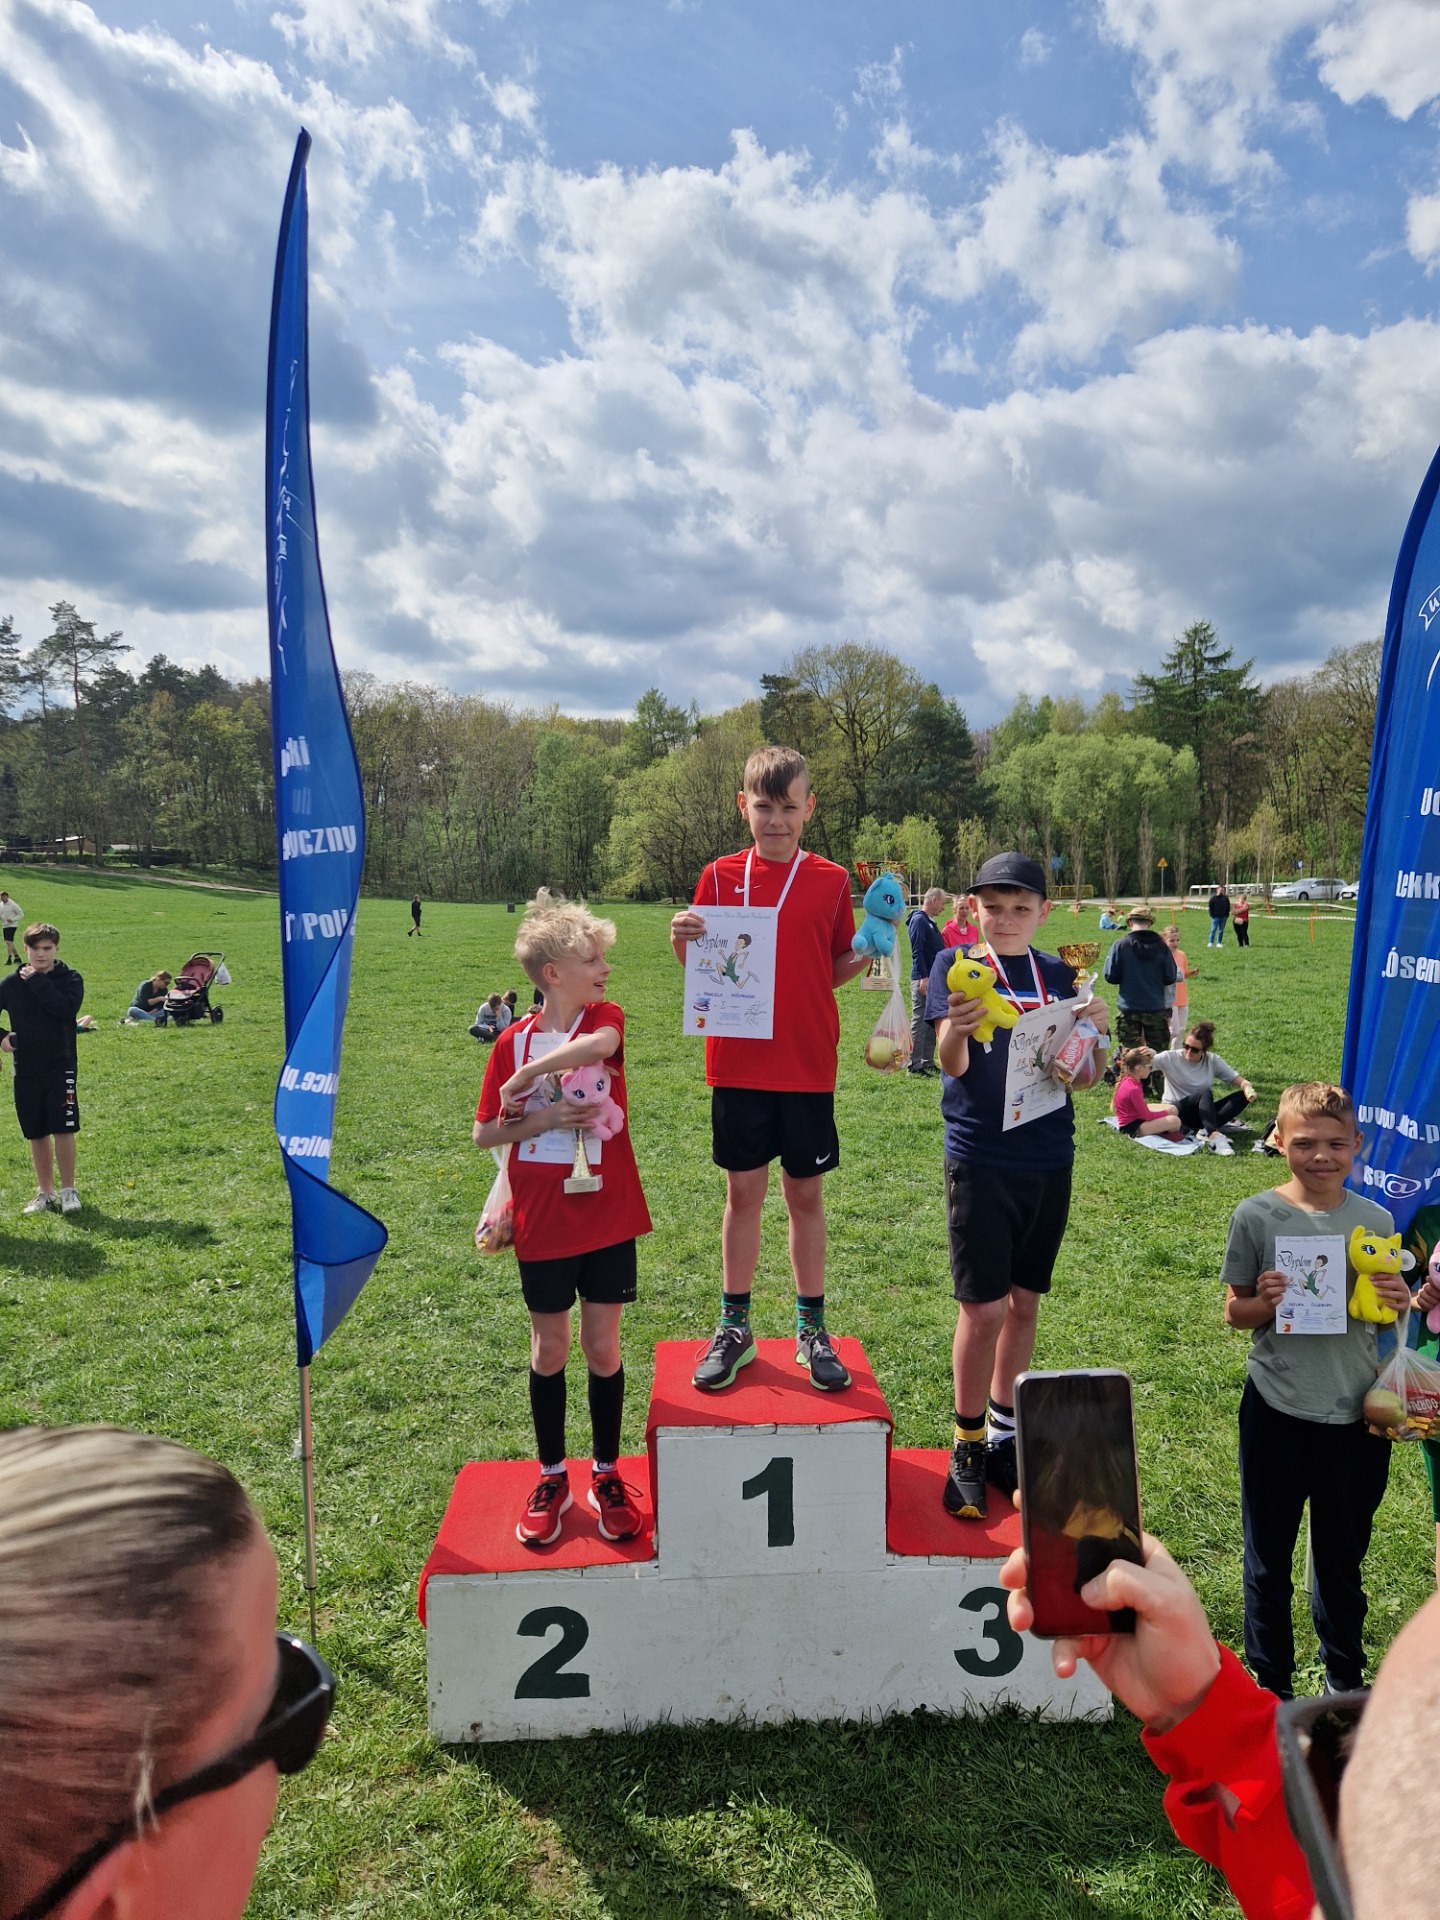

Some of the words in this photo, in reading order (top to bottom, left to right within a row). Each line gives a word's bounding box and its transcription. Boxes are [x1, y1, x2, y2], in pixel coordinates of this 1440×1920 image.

[742, 1456, 794, 1548] 1
[514, 1605, 591, 1700] 2
[953, 1586, 1024, 1678] 3
